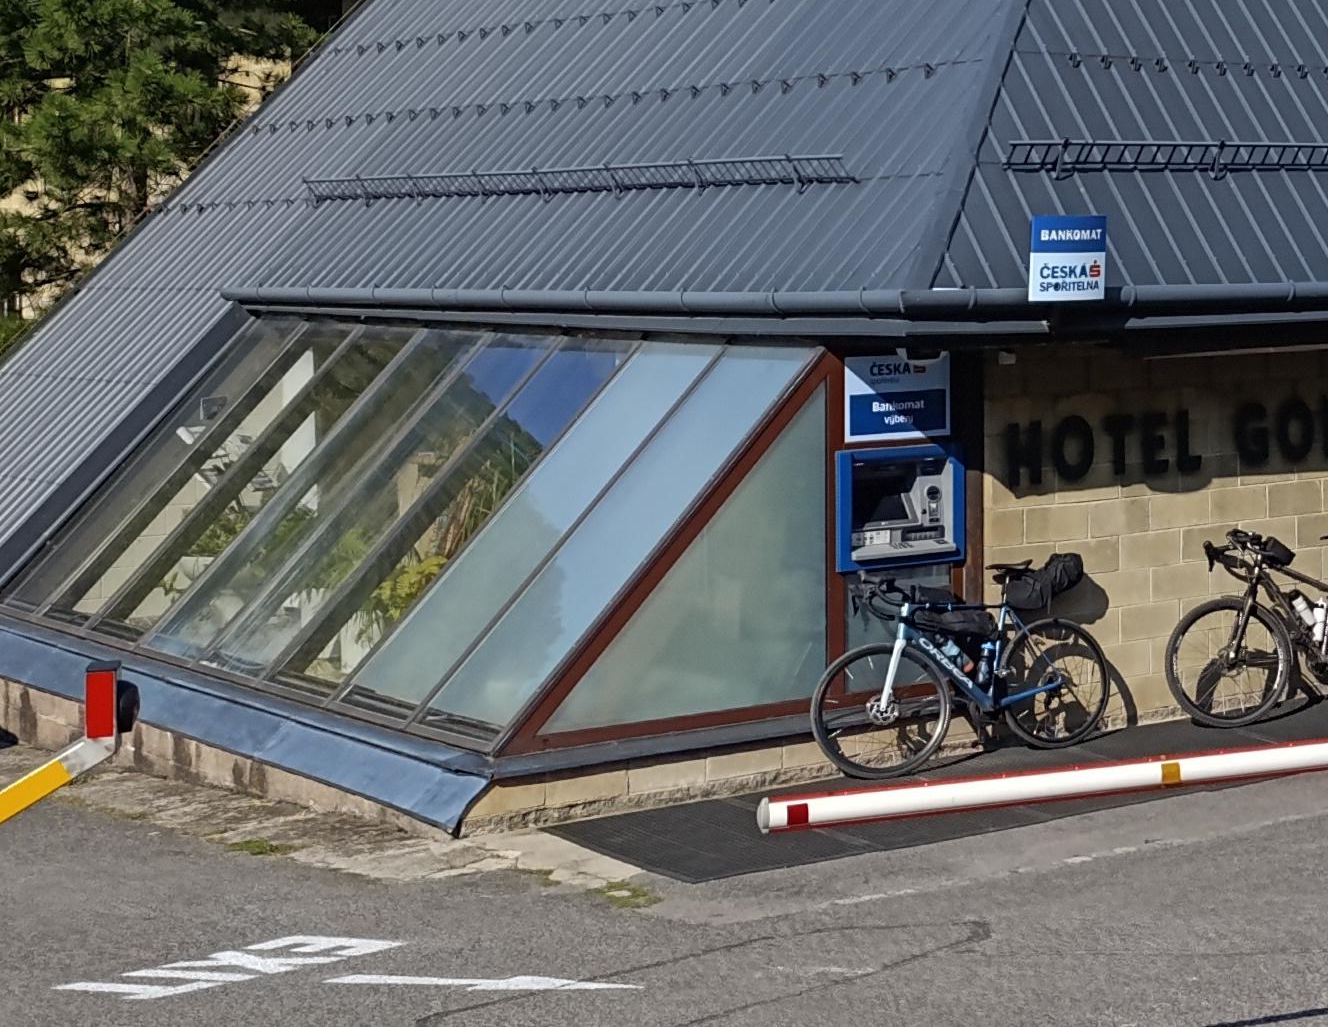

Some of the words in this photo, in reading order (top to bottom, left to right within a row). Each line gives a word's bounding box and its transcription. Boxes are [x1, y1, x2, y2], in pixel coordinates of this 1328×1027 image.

[1040, 229, 1102, 241] BANKOMAT
[1039, 280, 1099, 292] SPOŘITELNA
[872, 400, 925, 413] Bankomat
[1006, 409, 1203, 488] HOTEL
[919, 637, 974, 689] ORBEA
[51, 935, 406, 999] EXIT
